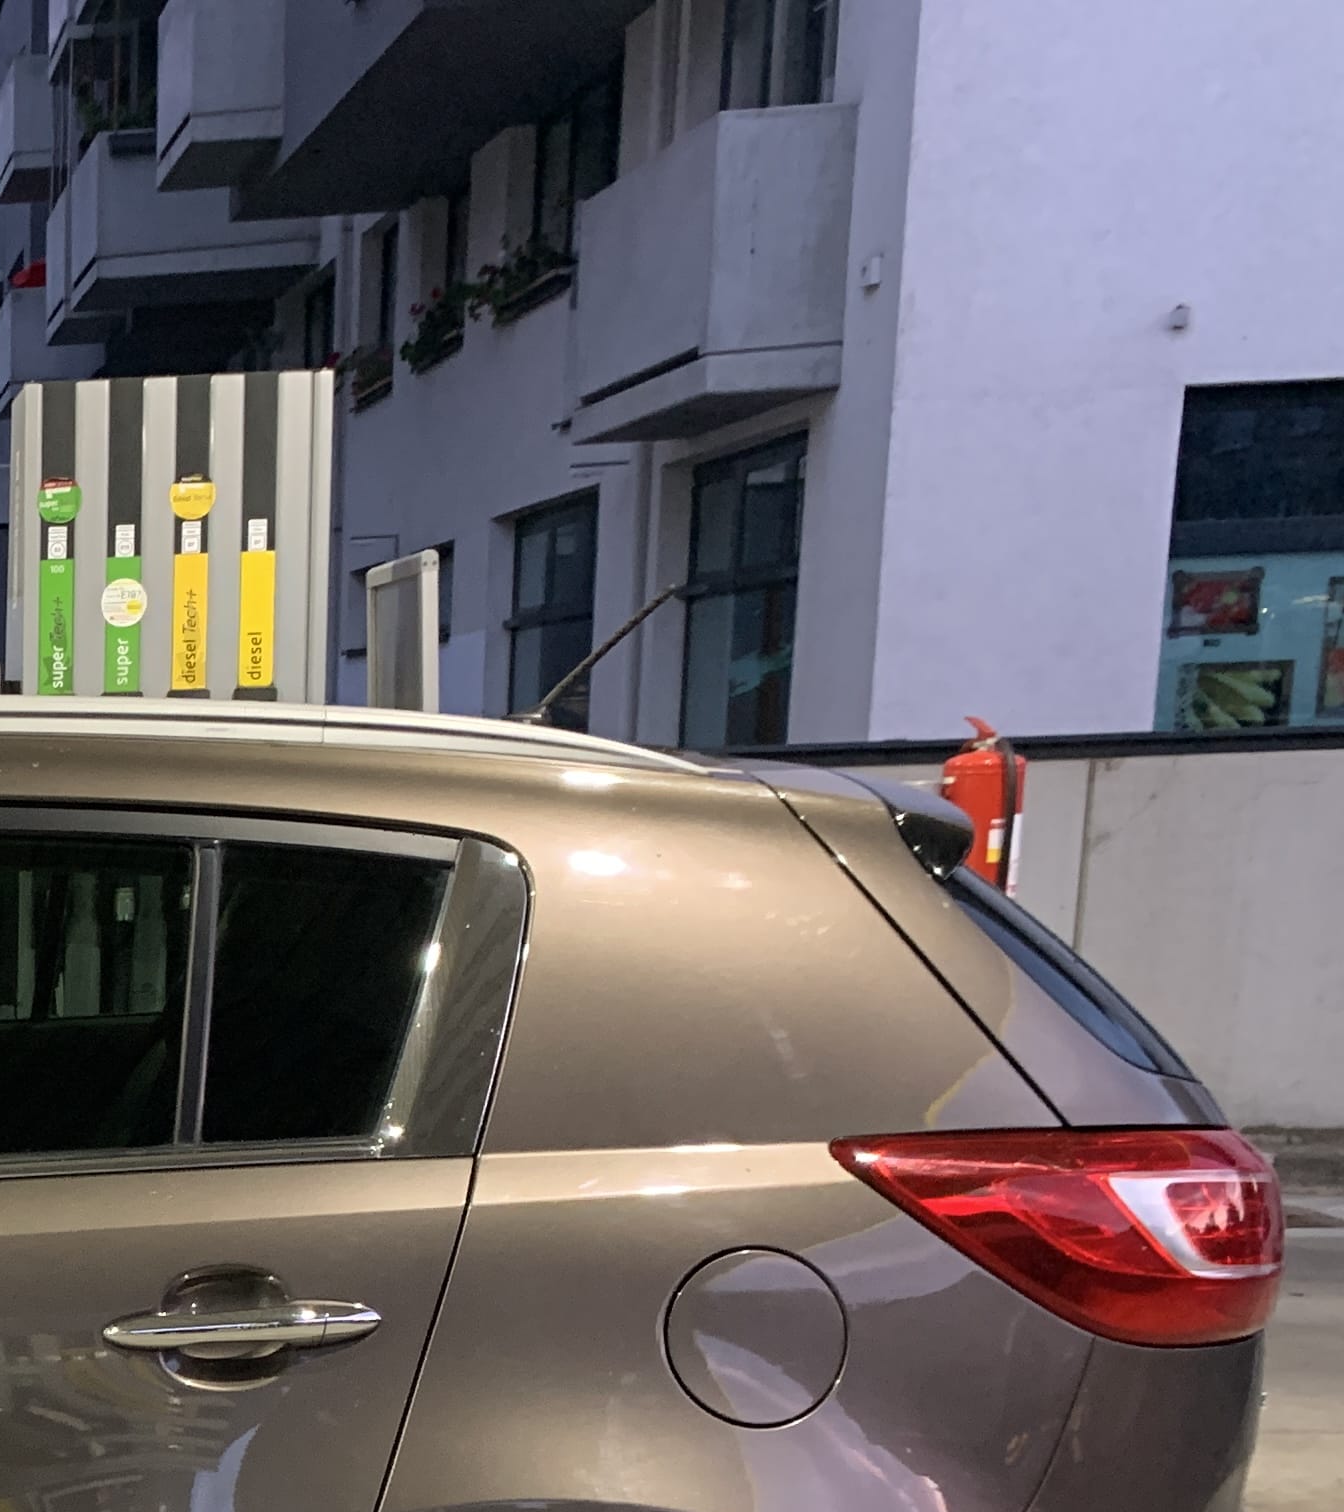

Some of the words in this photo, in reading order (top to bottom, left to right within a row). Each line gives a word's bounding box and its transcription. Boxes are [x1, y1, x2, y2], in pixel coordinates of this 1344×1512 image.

[50, 564, 65, 574] 100
[182, 588, 199, 635] Tech+
[52, 645, 68, 689] super
[116, 637, 132, 686] super
[181, 639, 197, 684] diesel
[247, 631, 262, 681] diesel
